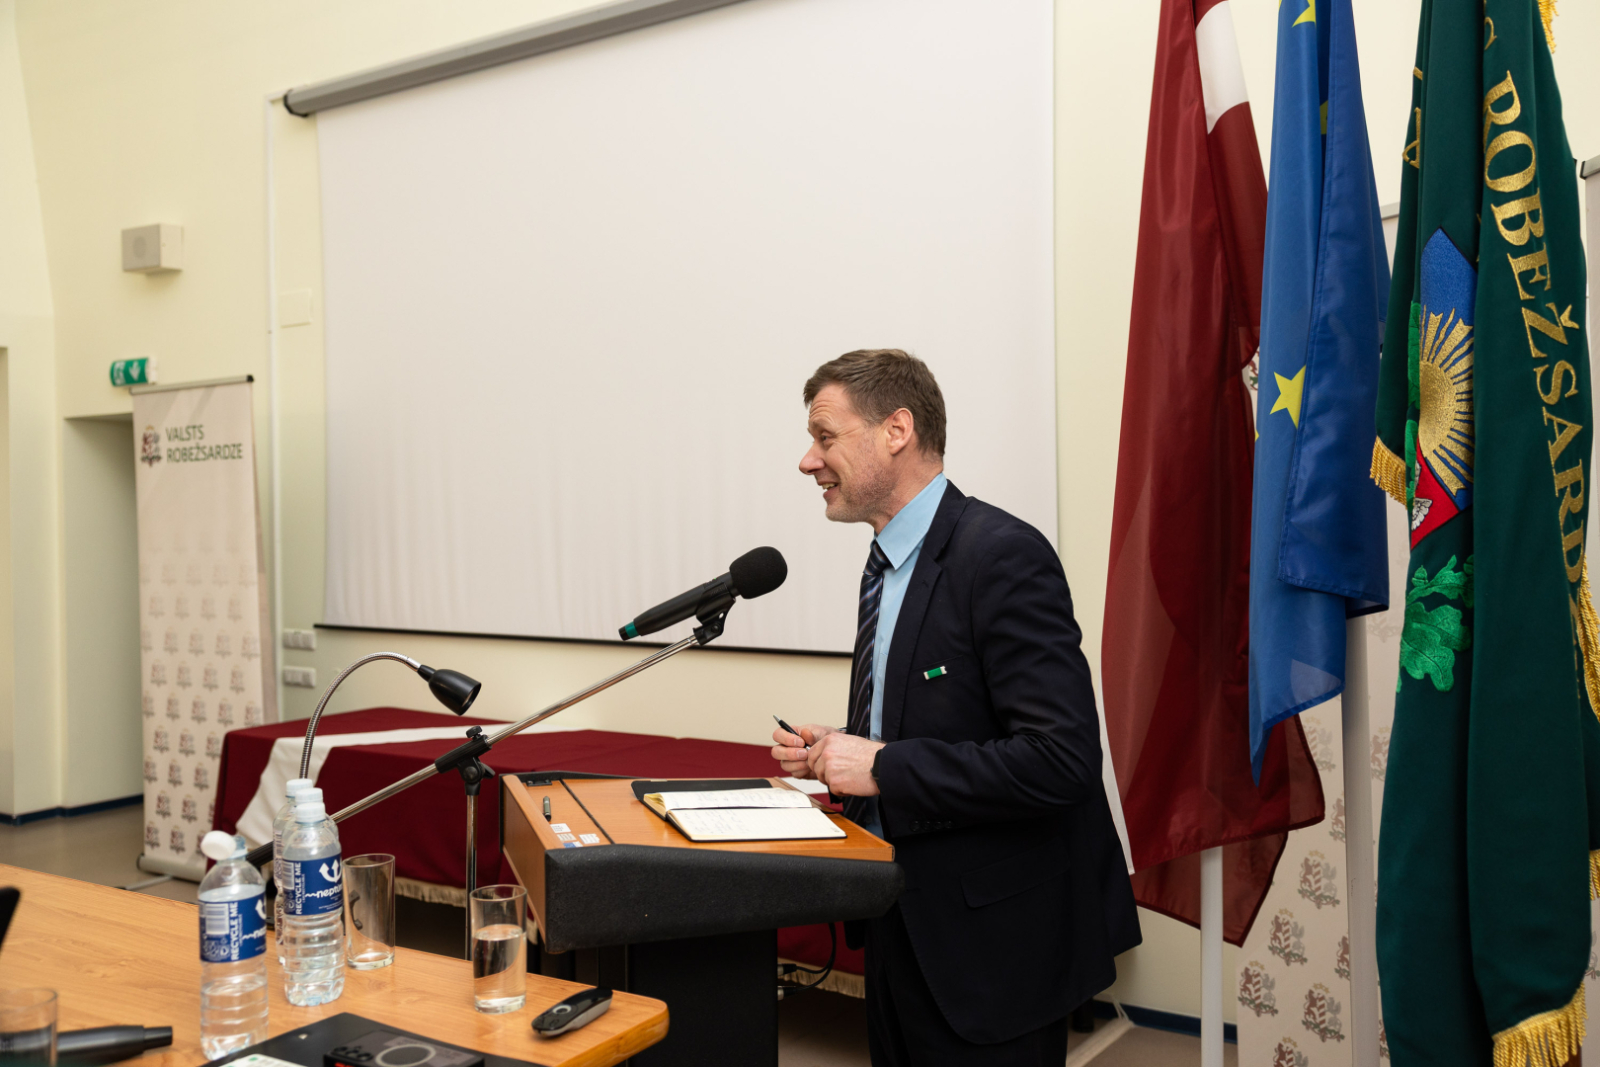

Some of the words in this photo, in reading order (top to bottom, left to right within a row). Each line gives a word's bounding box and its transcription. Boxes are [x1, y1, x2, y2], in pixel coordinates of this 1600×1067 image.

[1483, 69, 1585, 699] ROBEŽSARD
[165, 424, 204, 442] VALSTS
[166, 442, 243, 463] ROBEŽSARDZE
[294, 862, 302, 876] ME
[229, 901, 239, 918] ME
[230, 918, 240, 961] RECYCLE
